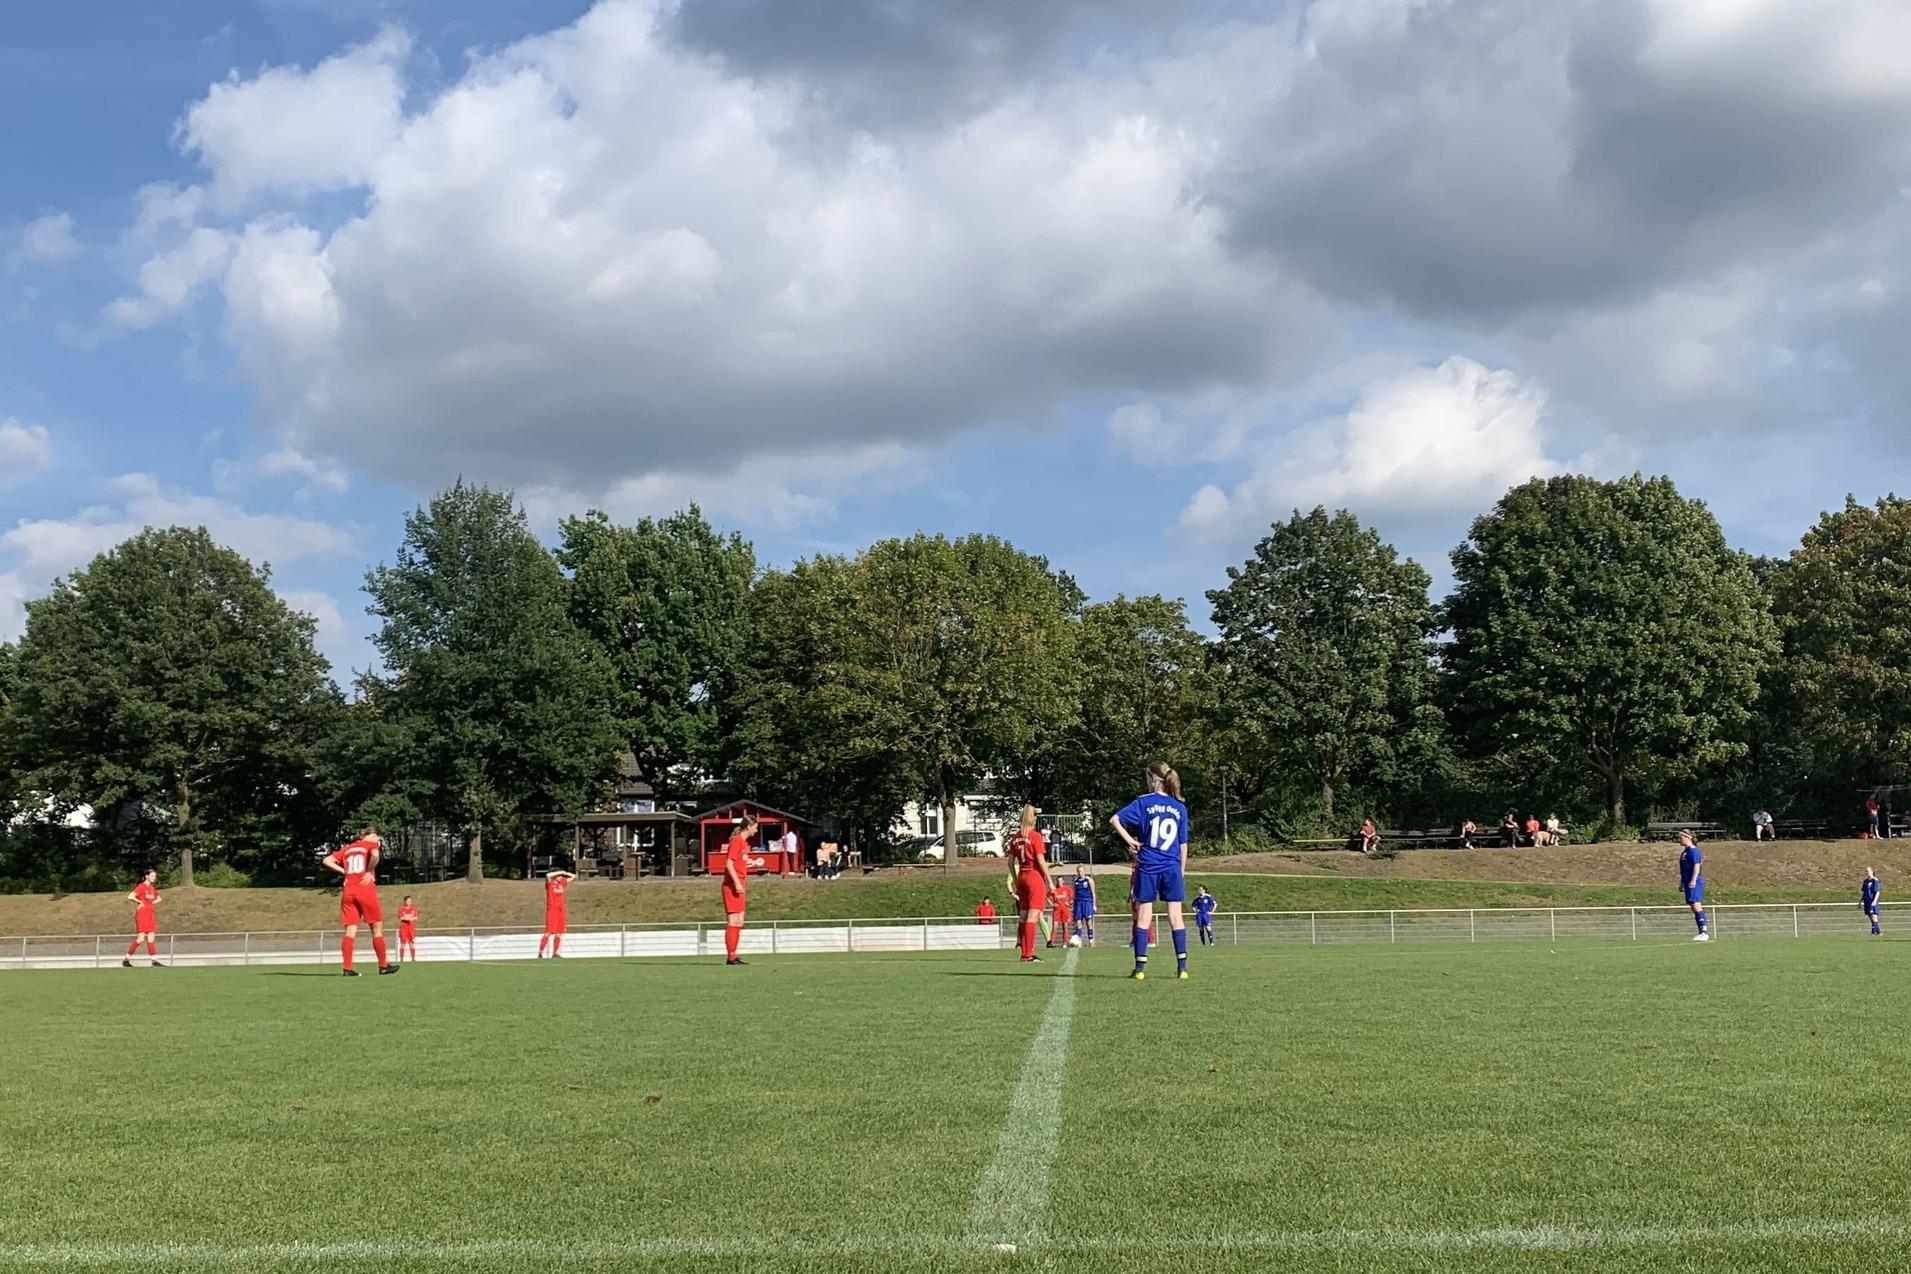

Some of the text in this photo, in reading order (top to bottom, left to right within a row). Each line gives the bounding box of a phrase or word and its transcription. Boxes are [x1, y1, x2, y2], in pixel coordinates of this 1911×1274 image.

[1150, 815, 1178, 851] 19
[1018, 844, 1026, 863] 7
[346, 854, 366, 874] 10
